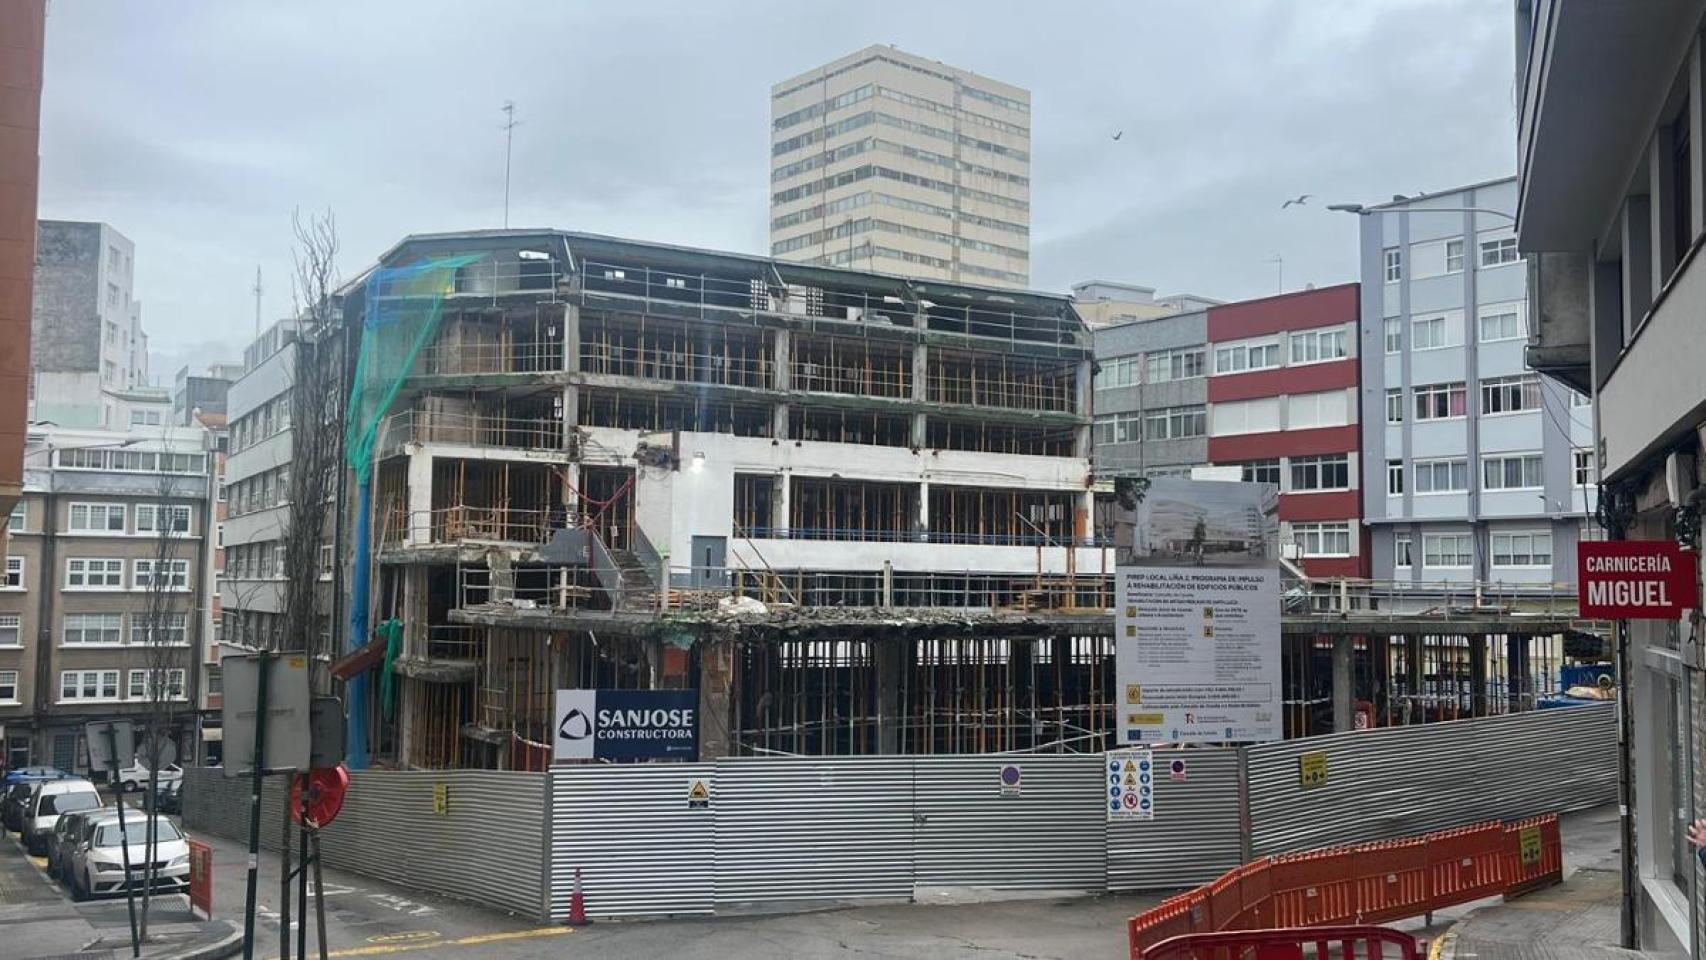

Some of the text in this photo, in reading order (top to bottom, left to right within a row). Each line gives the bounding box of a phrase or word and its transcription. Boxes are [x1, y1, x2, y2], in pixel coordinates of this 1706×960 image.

[1586, 553, 1672, 573] CARNICERÍA
[1587, 580, 1673, 607] MIGUEL
[598, 709, 694, 728] SANJOSE
[598, 729, 693, 739] CONSTRUCTORA
